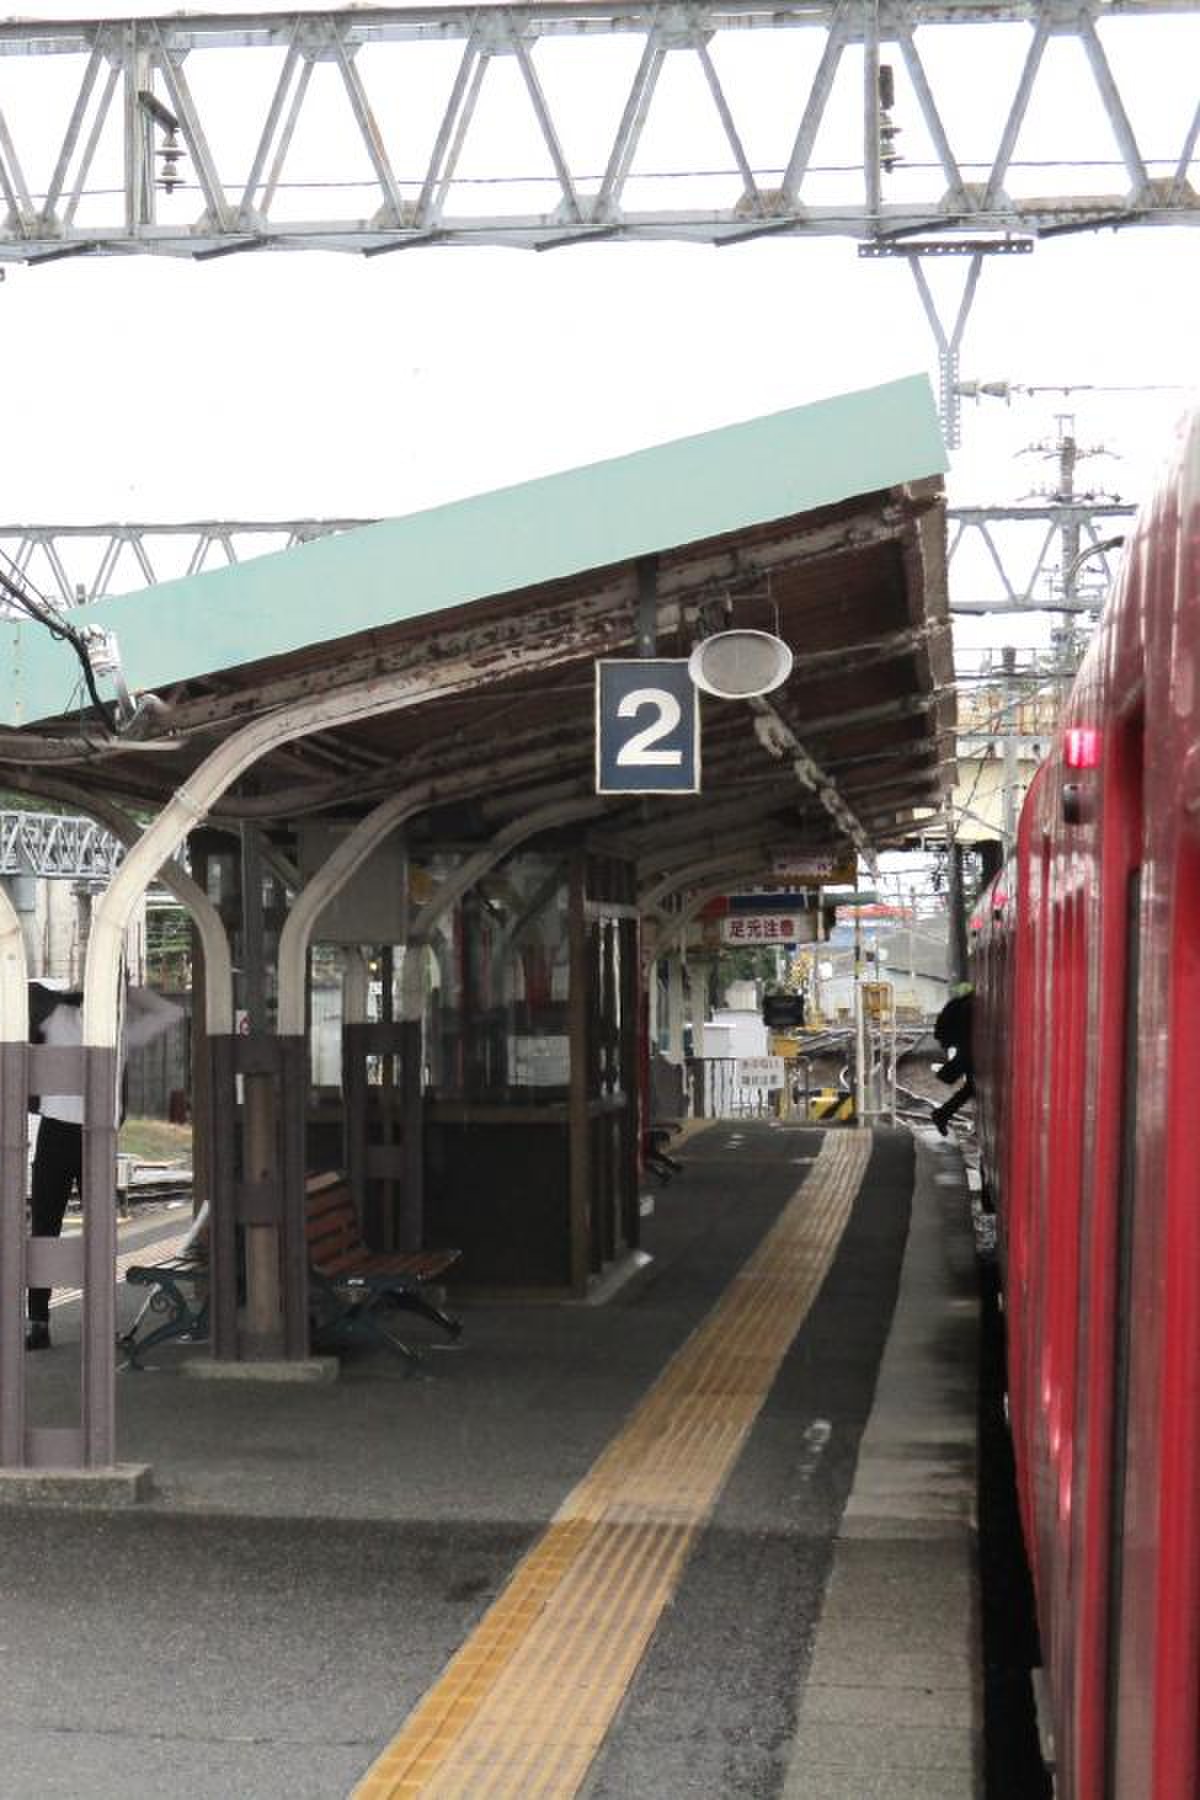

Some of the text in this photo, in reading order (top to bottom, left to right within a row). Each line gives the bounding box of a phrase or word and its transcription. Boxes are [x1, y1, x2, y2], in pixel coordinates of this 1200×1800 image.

[616, 687, 683, 766] 2
[728, 919, 794, 938] 足元注意
